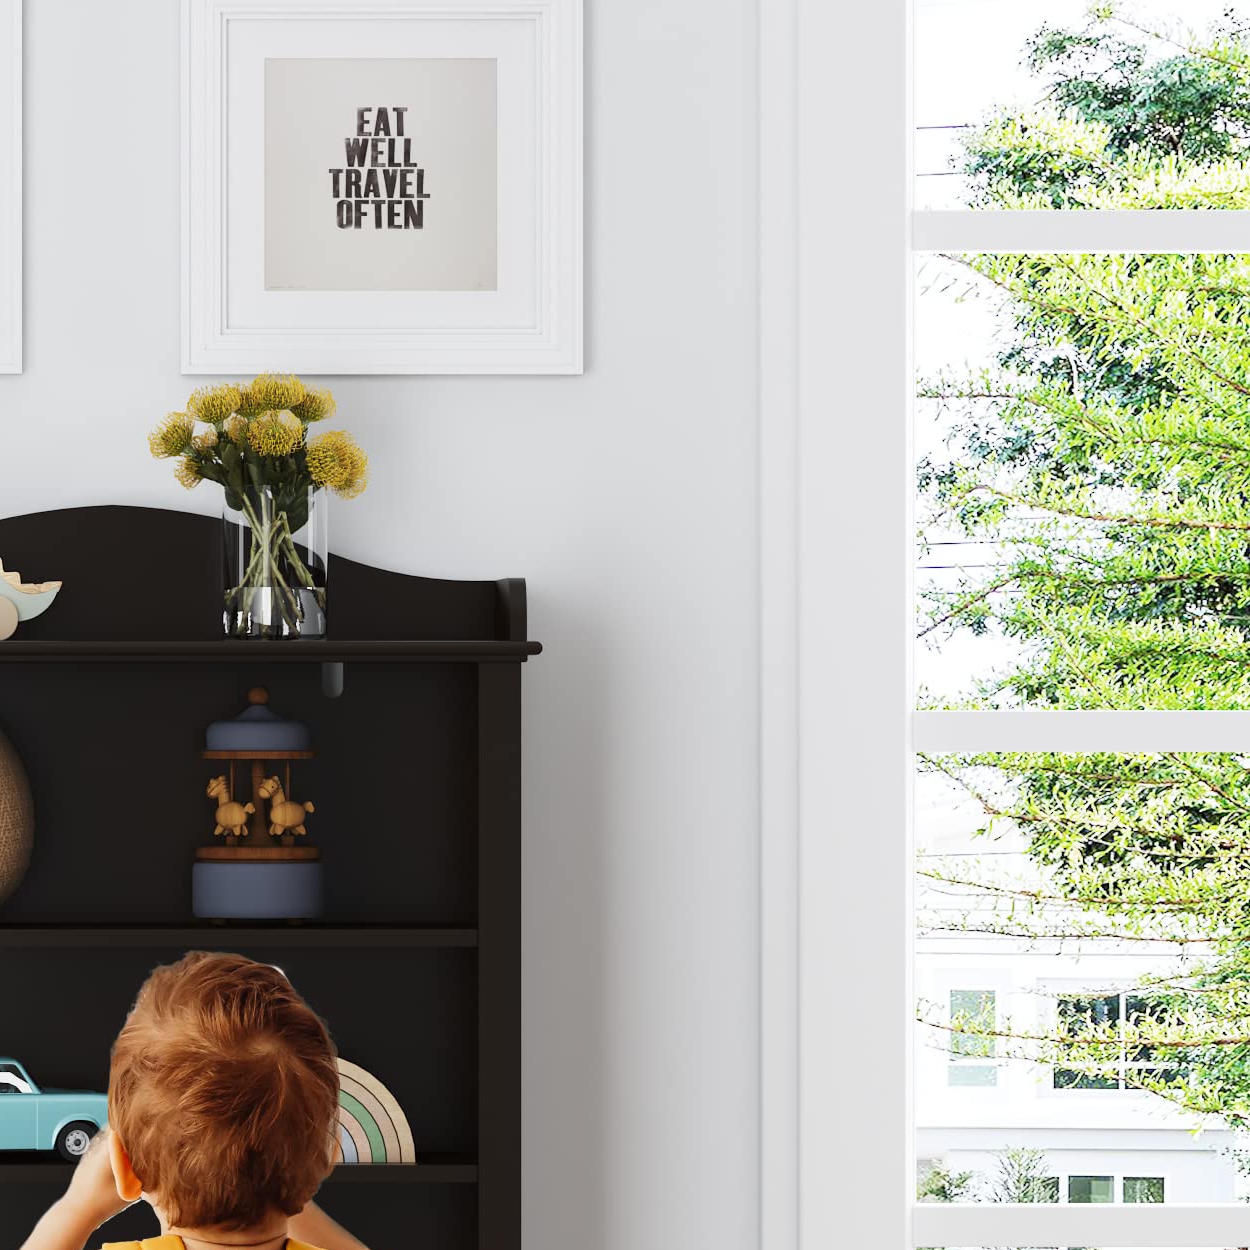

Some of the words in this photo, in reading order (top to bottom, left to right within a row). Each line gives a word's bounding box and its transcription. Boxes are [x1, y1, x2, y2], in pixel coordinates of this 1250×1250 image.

[356, 107, 408, 137] EAT
[344, 138, 418, 168] WELL
[328, 168, 431, 199] TRAVEL
[336, 199, 424, 230] OFTEN
